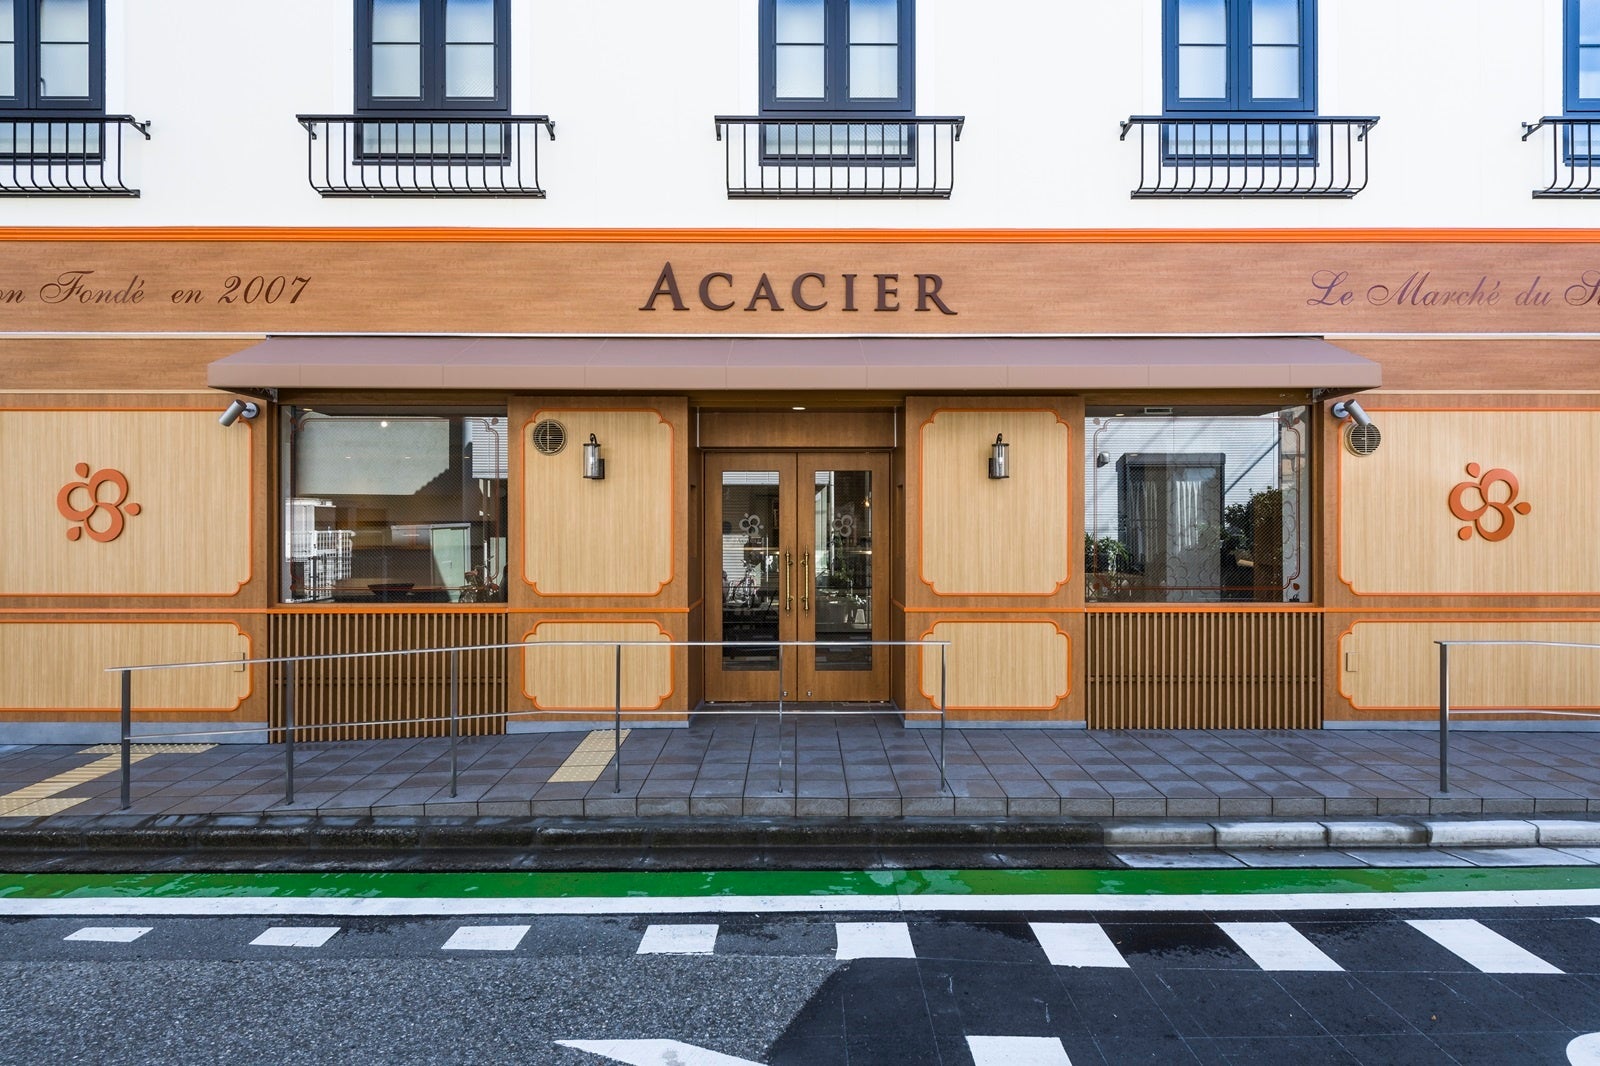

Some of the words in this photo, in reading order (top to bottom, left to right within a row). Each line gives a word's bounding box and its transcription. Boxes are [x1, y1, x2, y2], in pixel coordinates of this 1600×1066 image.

[40, 270, 145, 304] Fondé
[171, 288, 205, 304] en
[217, 275, 312, 304] 2007
[638, 261, 959, 315] ACACIER
[1306, 269, 1355, 306] Le
[1366, 271, 1501, 306] Marché
[1515, 275, 1552, 306] du
